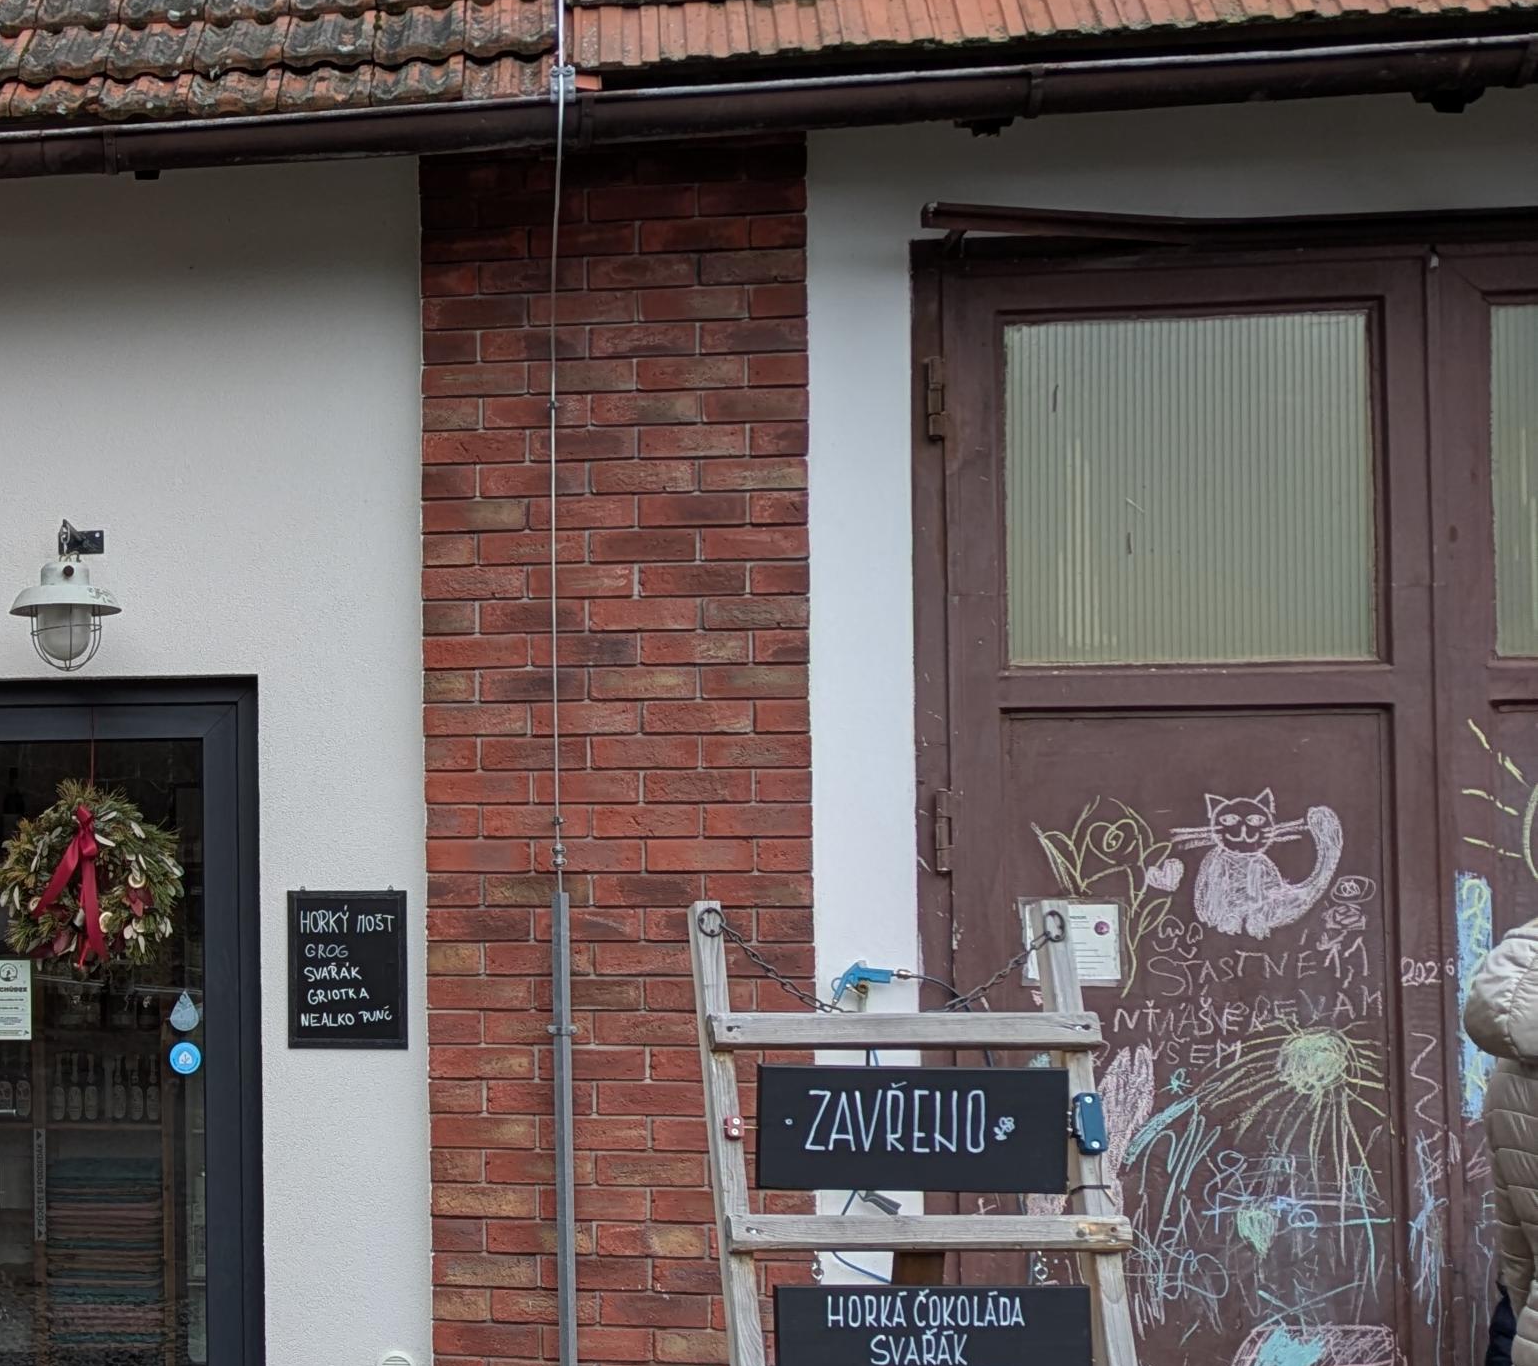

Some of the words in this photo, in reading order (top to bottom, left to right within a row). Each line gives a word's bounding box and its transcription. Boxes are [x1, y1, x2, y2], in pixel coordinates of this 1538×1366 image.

[300, 904, 350, 934] HORKÝ
[356, 913, 396, 933] MOŠT
[305, 943, 349, 959] GROG
[303, 962, 362, 982] SVAŘÁK
[307, 987, 370, 1005] GRIOTKA
[300, 1012, 355, 1027] NEALKO
[804, 1081, 986, 1153] ZAVŘENO
[827, 1291, 908, 1328] HORKÁ
[913, 1289, 1026, 1328] ČOKOLÁDA
[870, 1328, 969, 1366] SVAŘÁK
